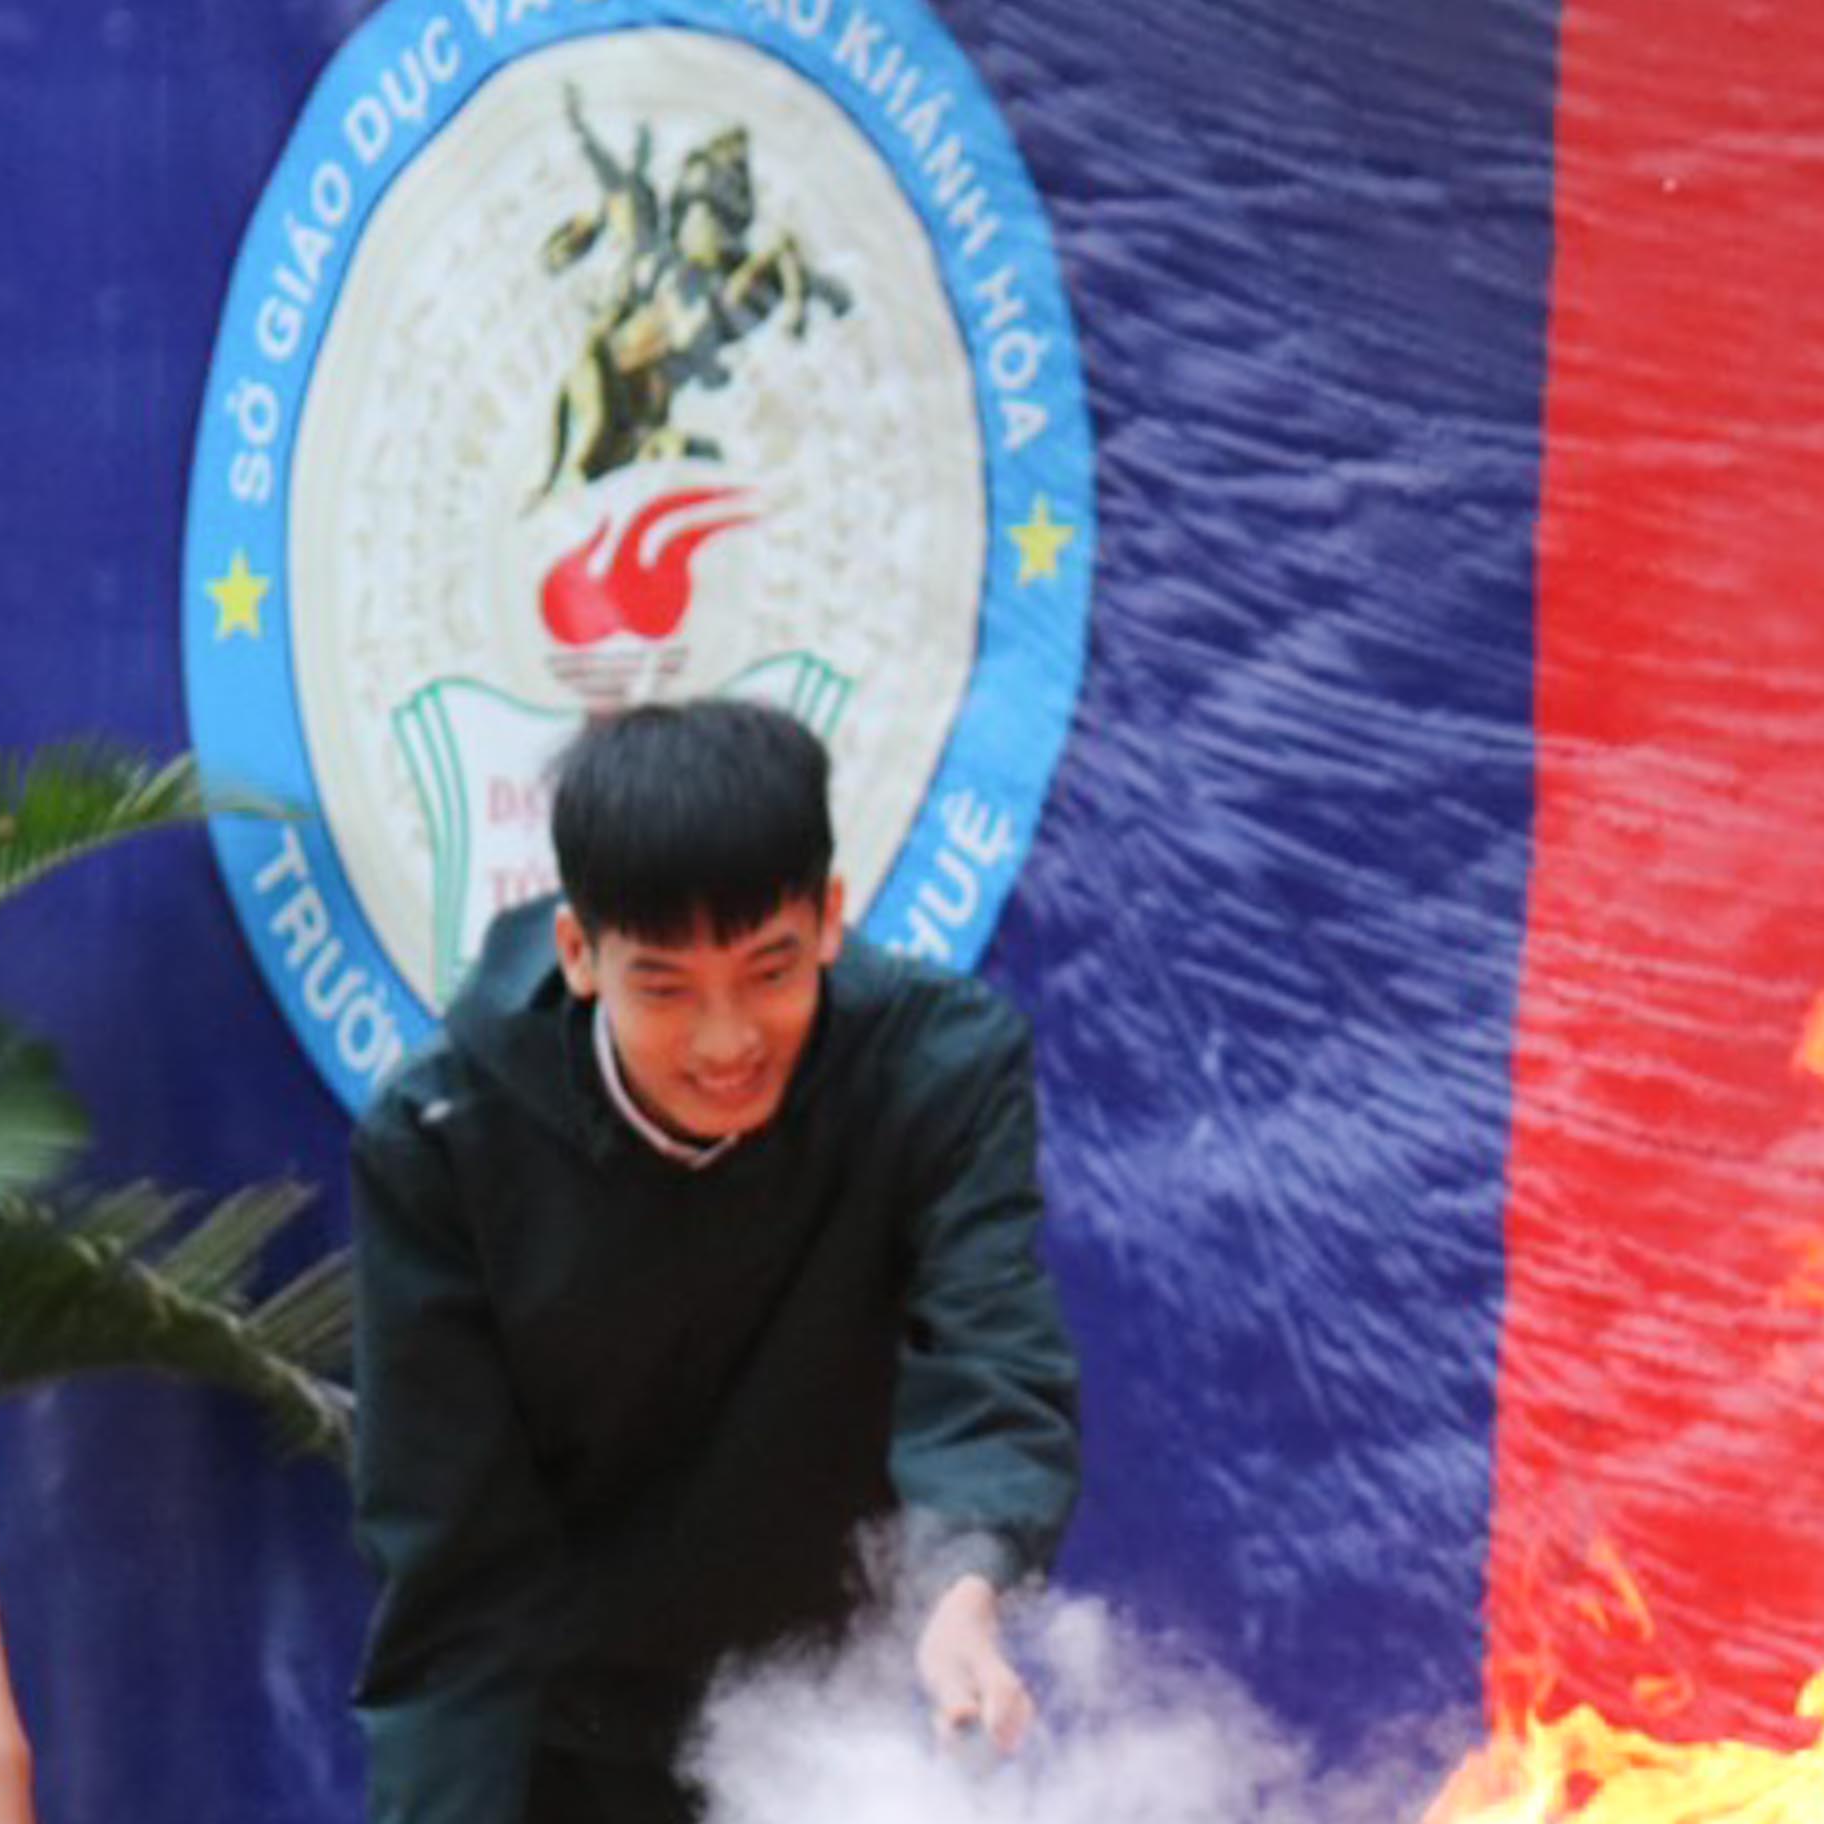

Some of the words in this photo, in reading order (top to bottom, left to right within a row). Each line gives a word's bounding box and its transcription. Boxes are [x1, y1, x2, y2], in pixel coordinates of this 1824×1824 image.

[255, 160, 351, 362] GIÁO
[831, 6, 1004, 260] KHÁNH
[974, 264, 1052, 452] HÓA
